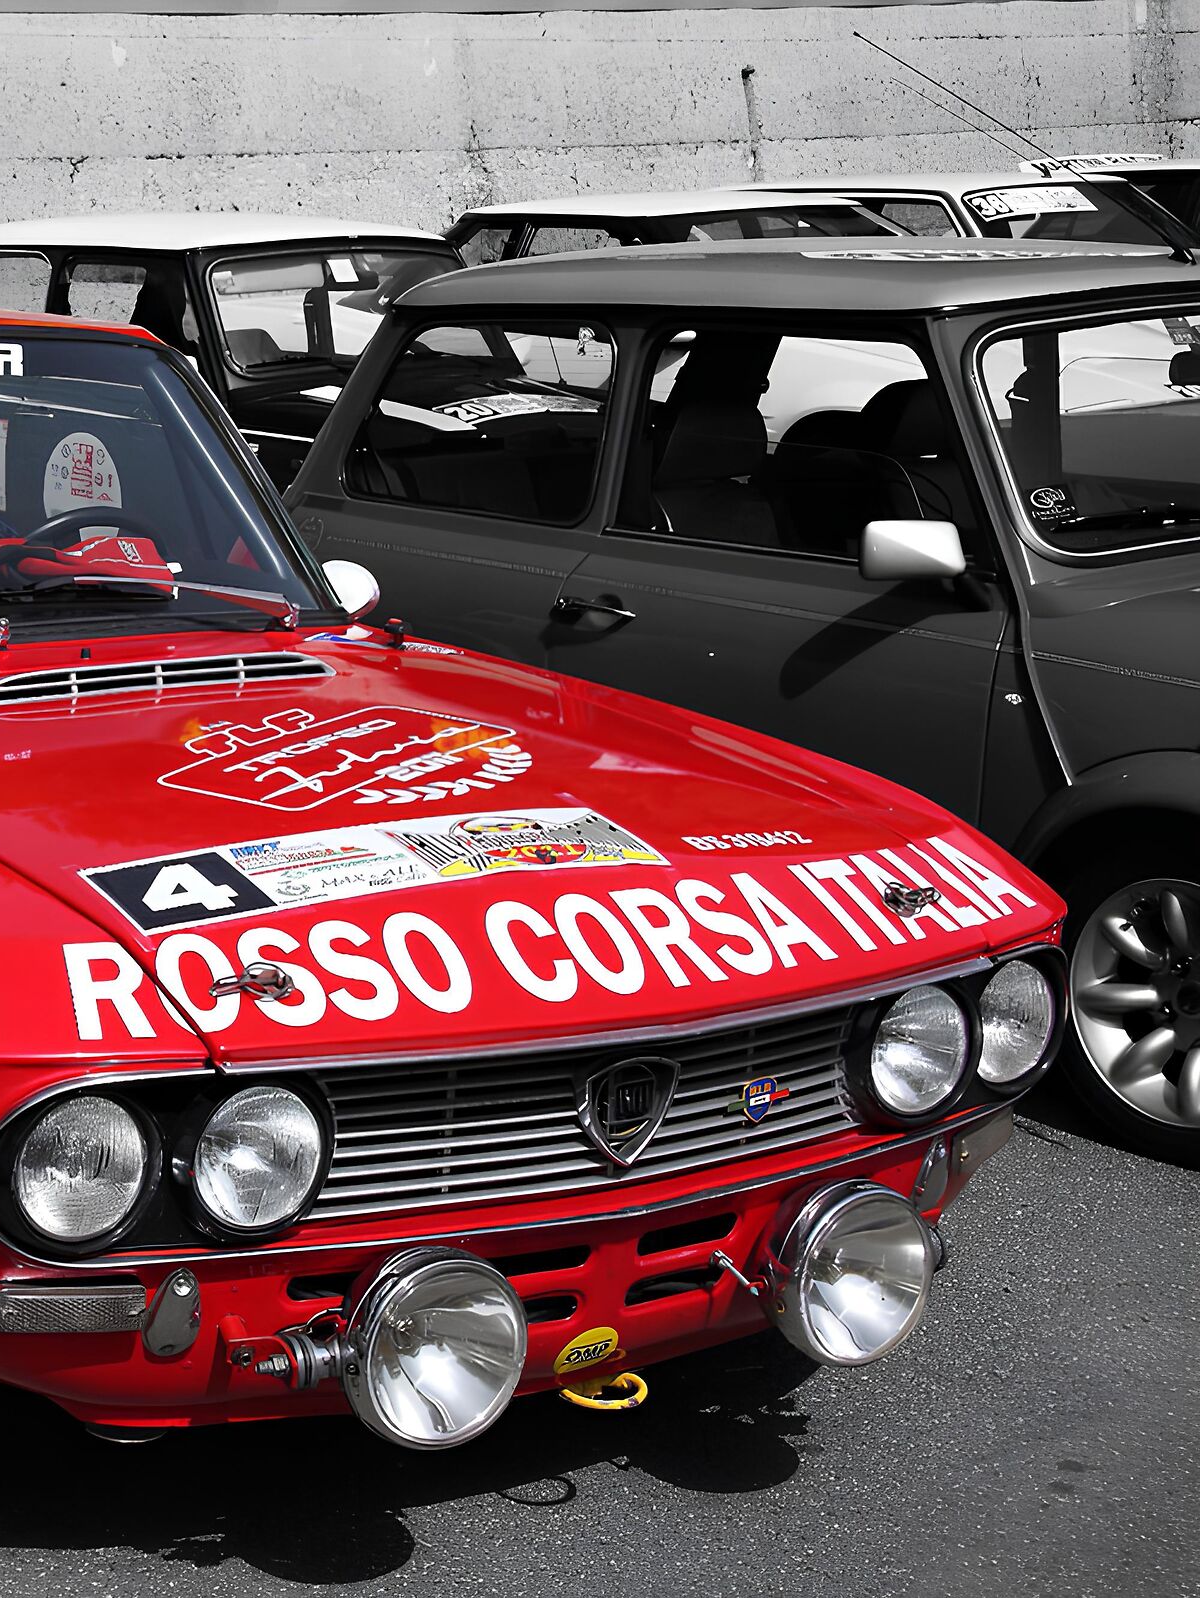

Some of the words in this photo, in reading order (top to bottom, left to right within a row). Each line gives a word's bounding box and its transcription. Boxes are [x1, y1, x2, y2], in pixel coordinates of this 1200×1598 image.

[63, 911, 473, 1042] ROSSO
[492, 871, 840, 1005] CORSA
[794, 835, 1038, 952] ITALIA
[141, 863, 239, 912] 4
